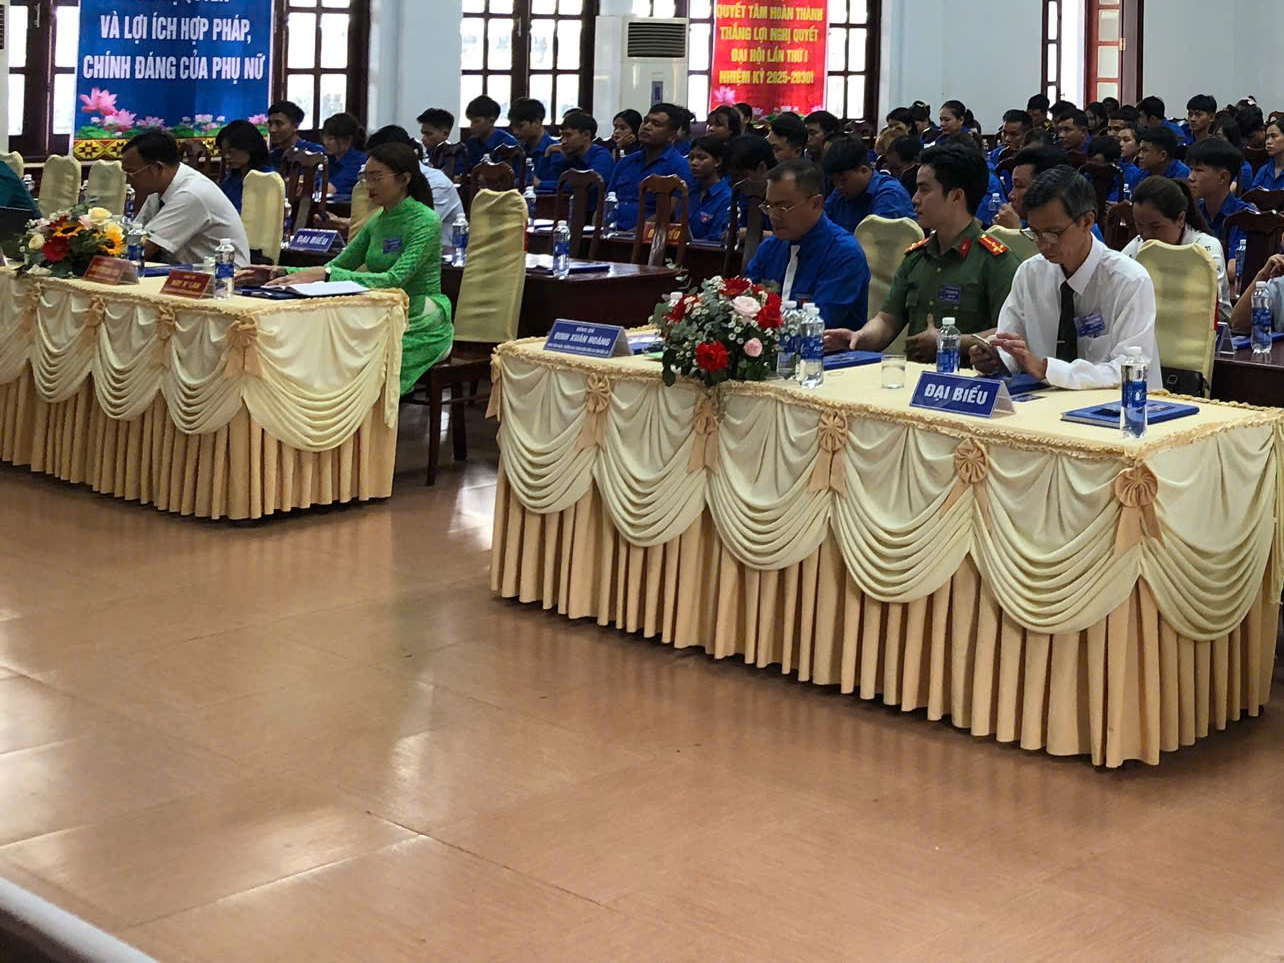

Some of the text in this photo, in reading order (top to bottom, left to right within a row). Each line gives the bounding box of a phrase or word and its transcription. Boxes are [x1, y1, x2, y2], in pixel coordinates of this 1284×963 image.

[717, 1, 823, 21] QUYẾT TÂM HOÀN THÀNH
[100, 9, 251, 46] VÀ LỢI ÍCH HỢP PHÁP,
[793, 25, 819, 42] QUYẾT
[83, 47, 265, 84] CHÍNH ĐÁNG CỦA PHỤ NỮ
[750, 47, 765, 65] HỘI
[924, 383, 988, 405] ĐẠI BIỂU
